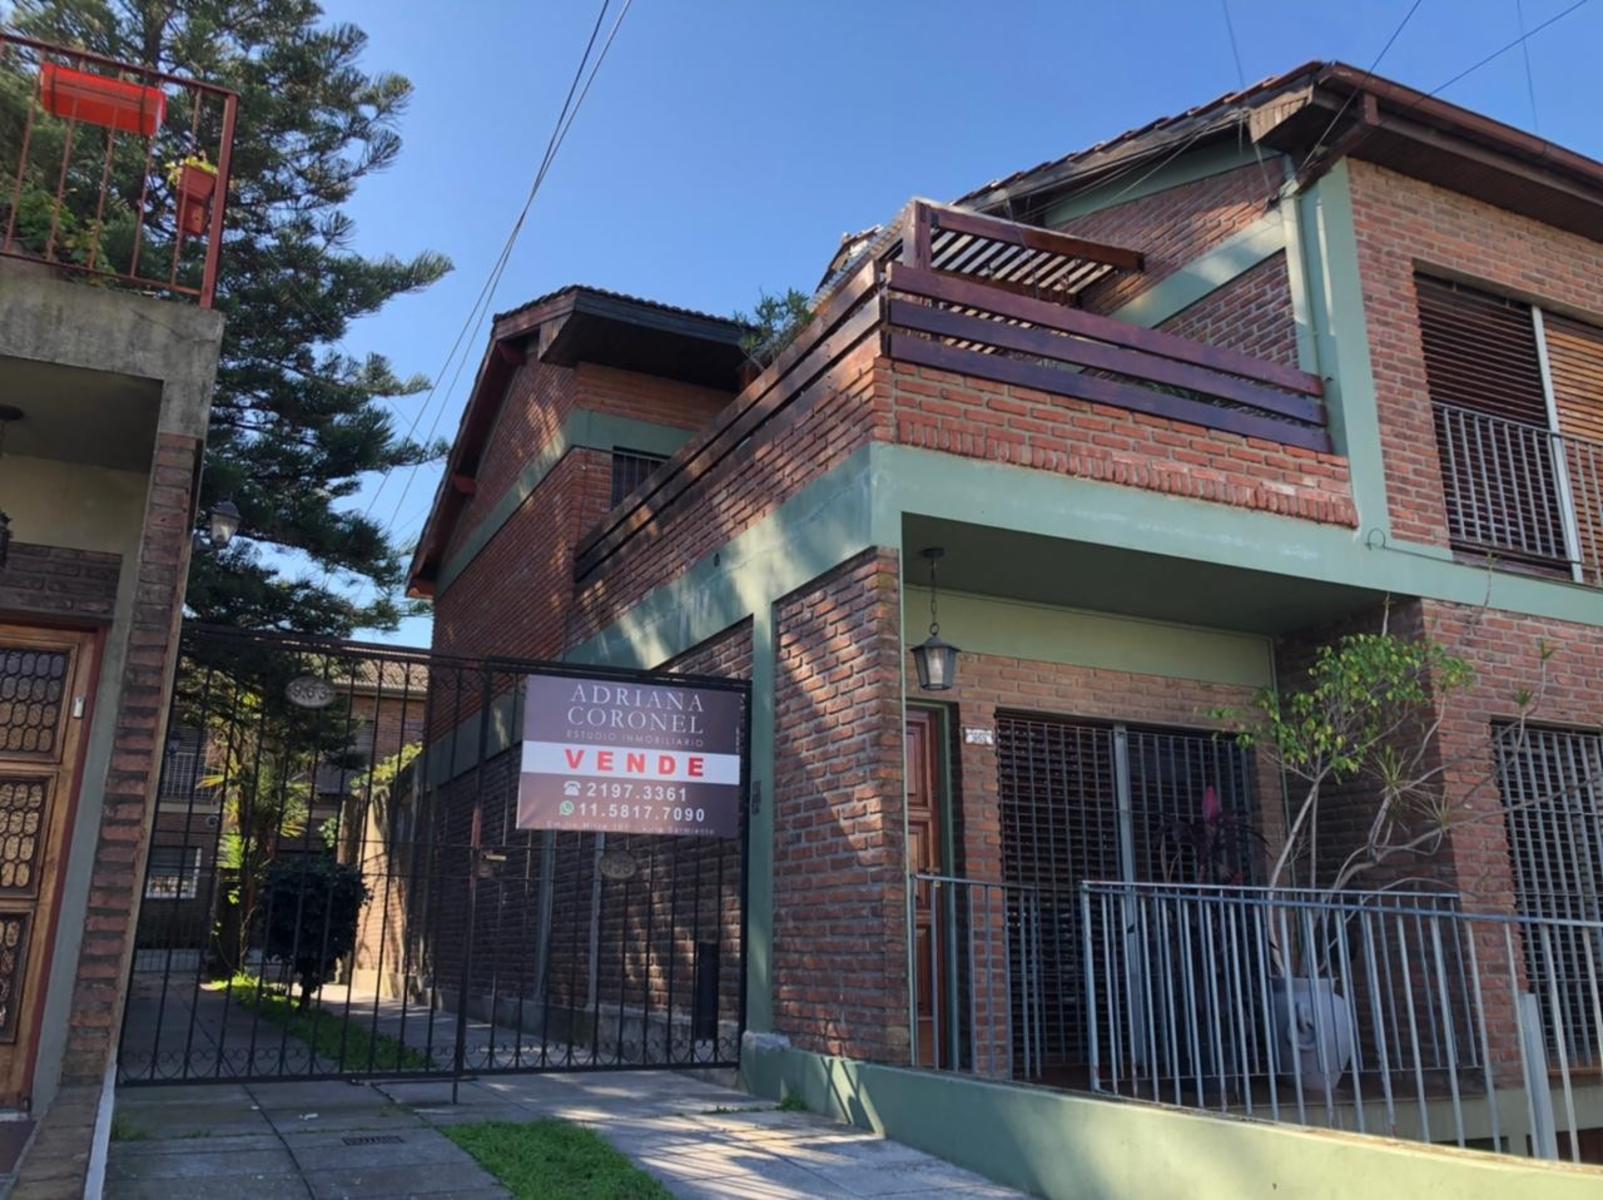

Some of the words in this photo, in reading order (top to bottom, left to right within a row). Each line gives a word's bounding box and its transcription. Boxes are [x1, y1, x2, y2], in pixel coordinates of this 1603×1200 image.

[571, 683, 704, 712] ADRIANA
[567, 705, 704, 734] CORONEL
[566, 729, 616, 740] ESTUDIO
[622, 733, 704, 748] INMOBILIARIO
[564, 748, 704, 777] VENDE
[586, 781, 687, 802] 2197.3361
[579, 802, 705, 822] 11.5817.7090
